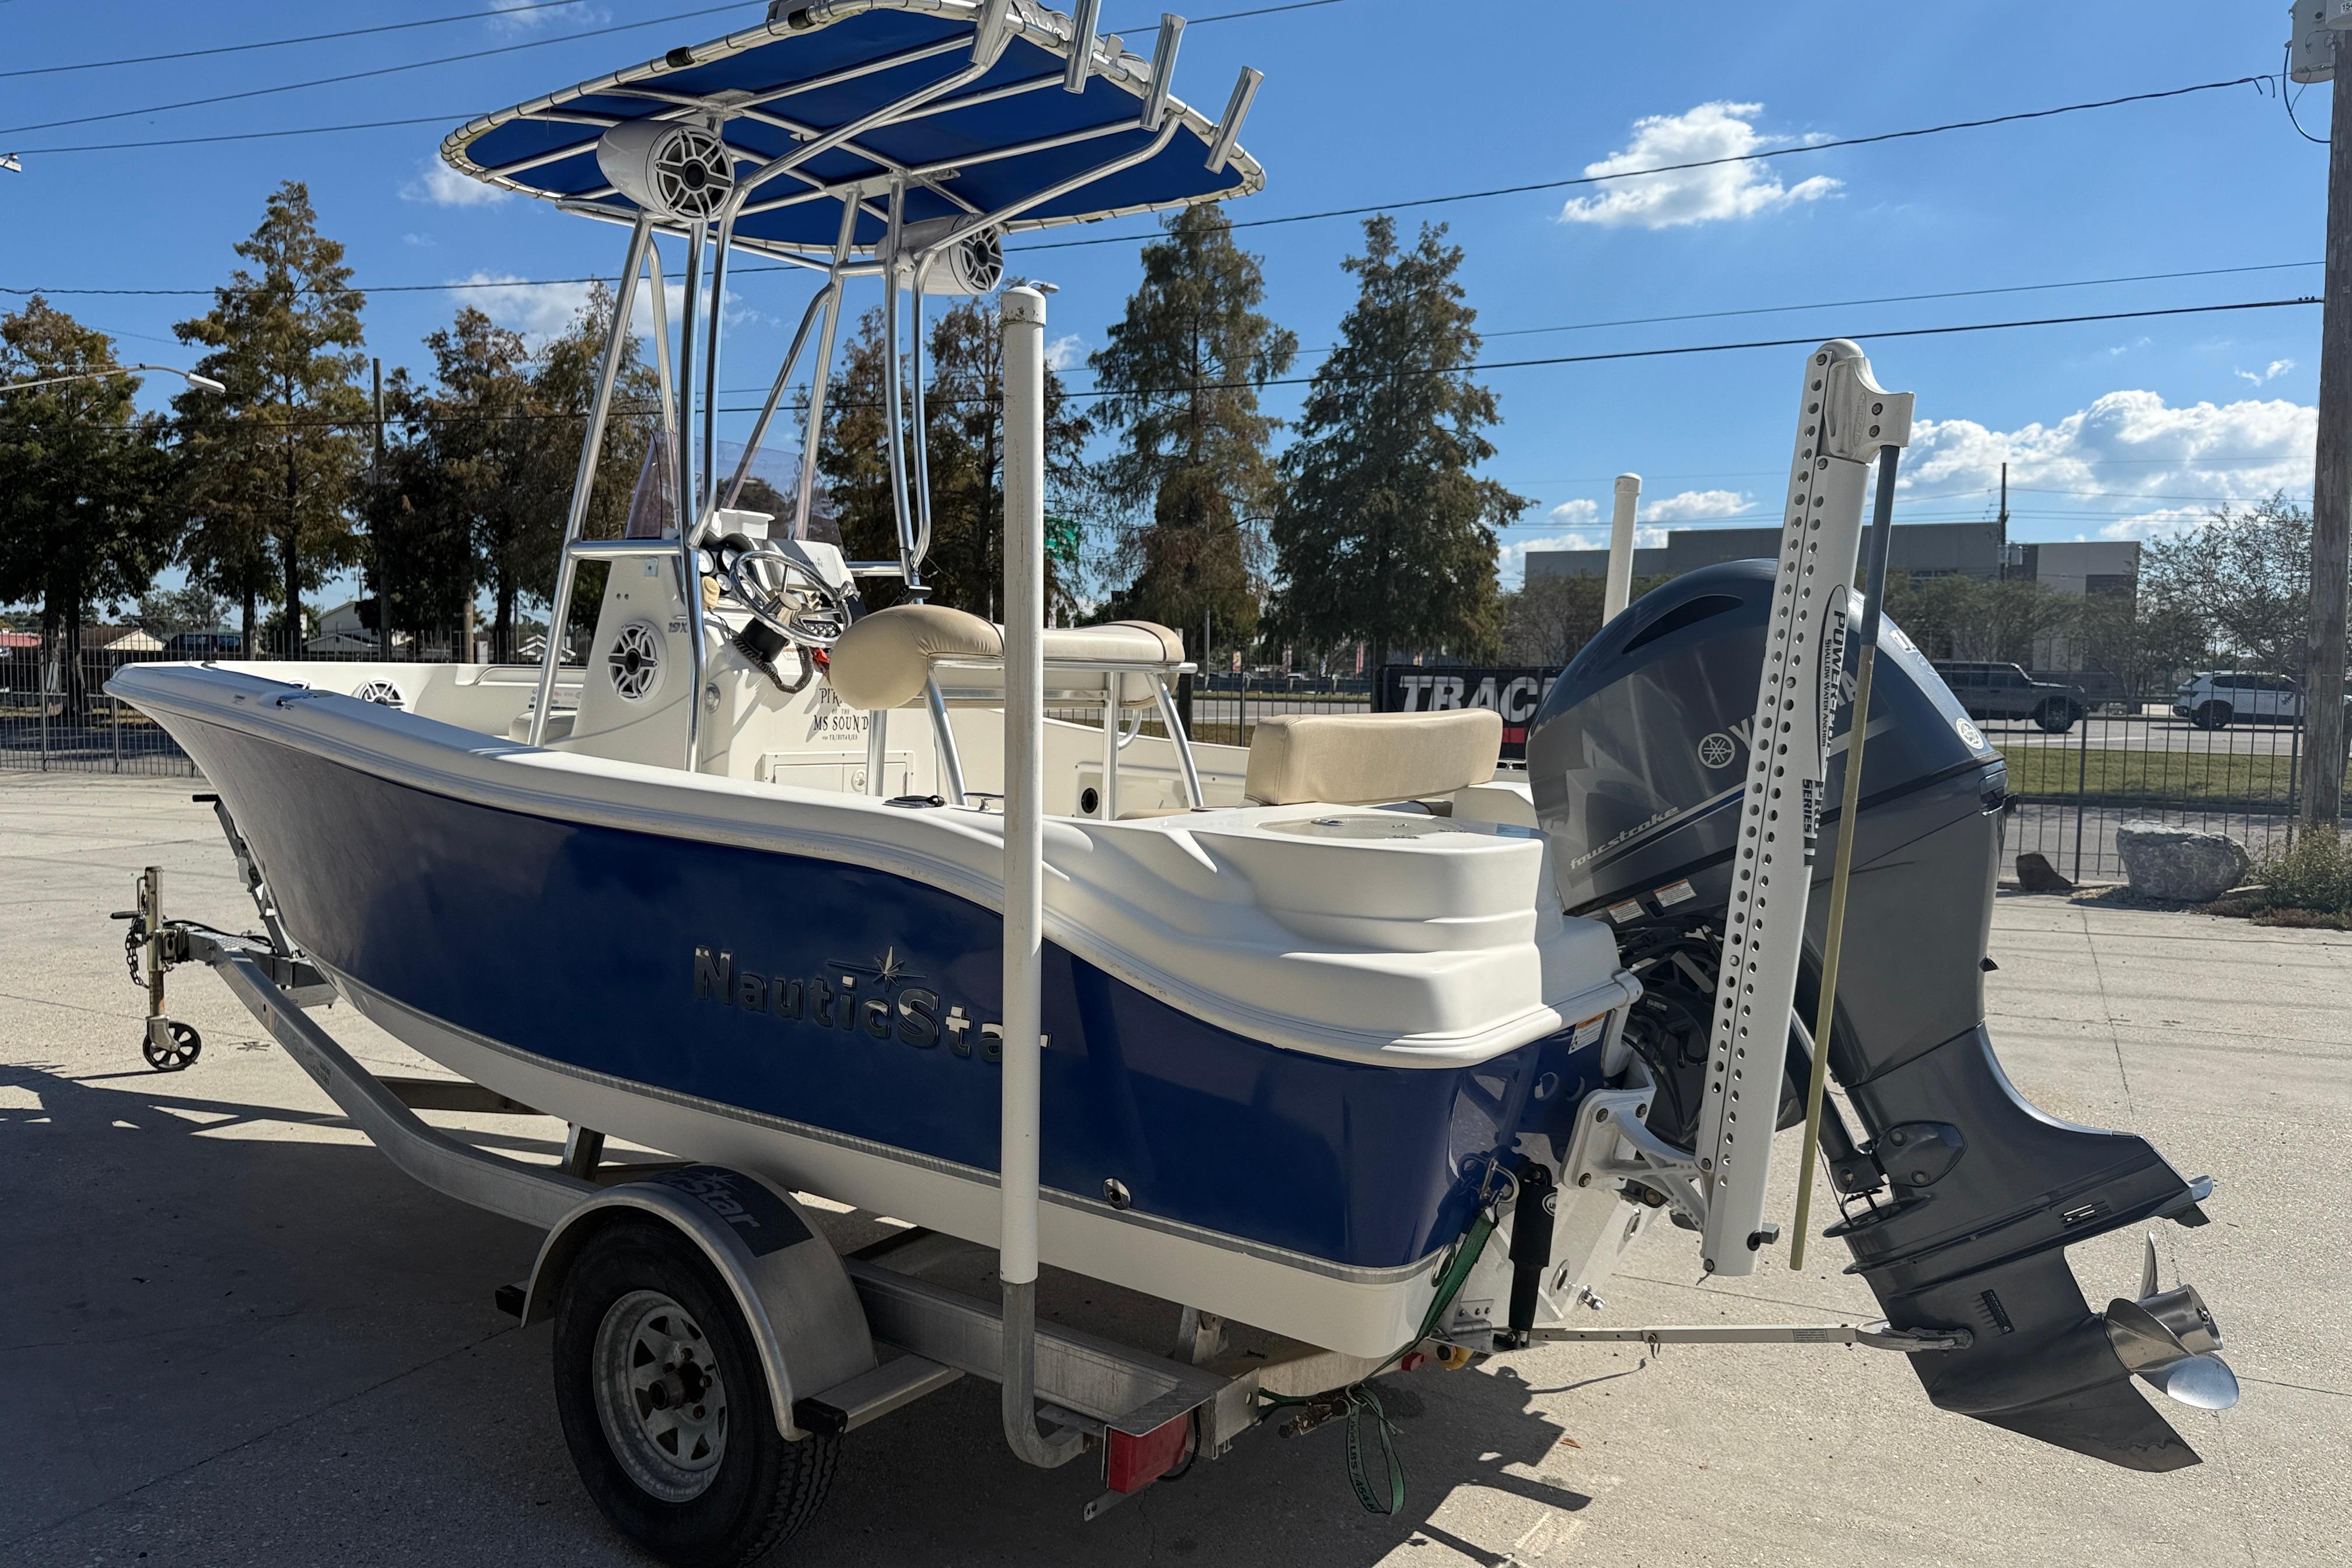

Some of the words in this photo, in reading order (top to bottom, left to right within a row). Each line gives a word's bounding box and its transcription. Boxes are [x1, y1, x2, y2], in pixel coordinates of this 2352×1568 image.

[1824, 639, 1832, 679] SHALLOW
[1399, 675, 1559, 723] TRAC
[813, 715, 828, 731] MS
[832, 715, 869, 733] SOUND
[1803, 779, 1812, 833] SERIES
[1350, 1445, 1358, 1470] LBS
